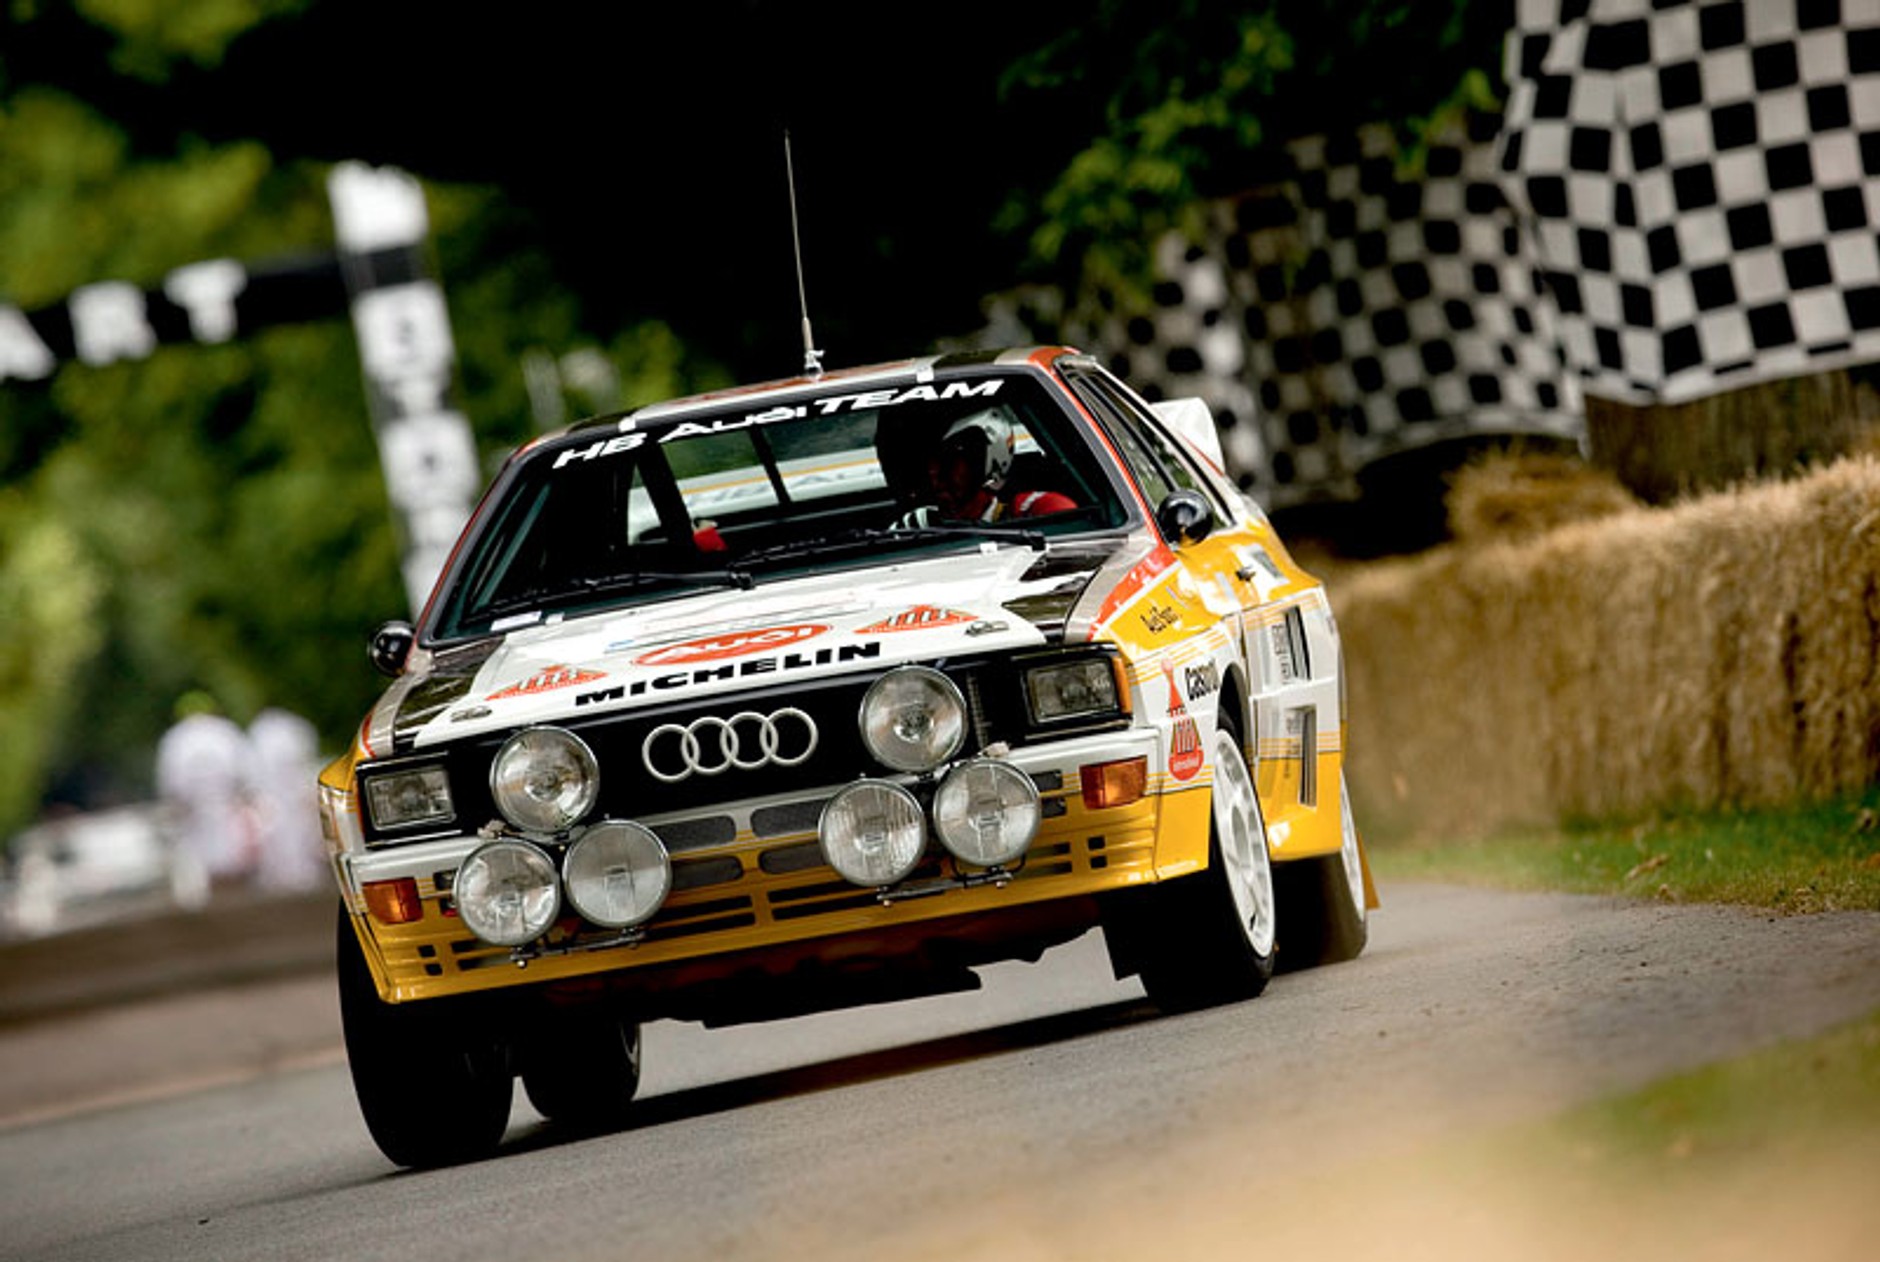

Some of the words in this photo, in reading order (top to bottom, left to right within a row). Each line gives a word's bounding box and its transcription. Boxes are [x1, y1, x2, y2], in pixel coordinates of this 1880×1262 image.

[552, 431, 648, 469] HB
[815, 380, 1004, 413] TEAM
[576, 642, 880, 706] MICHELIN
